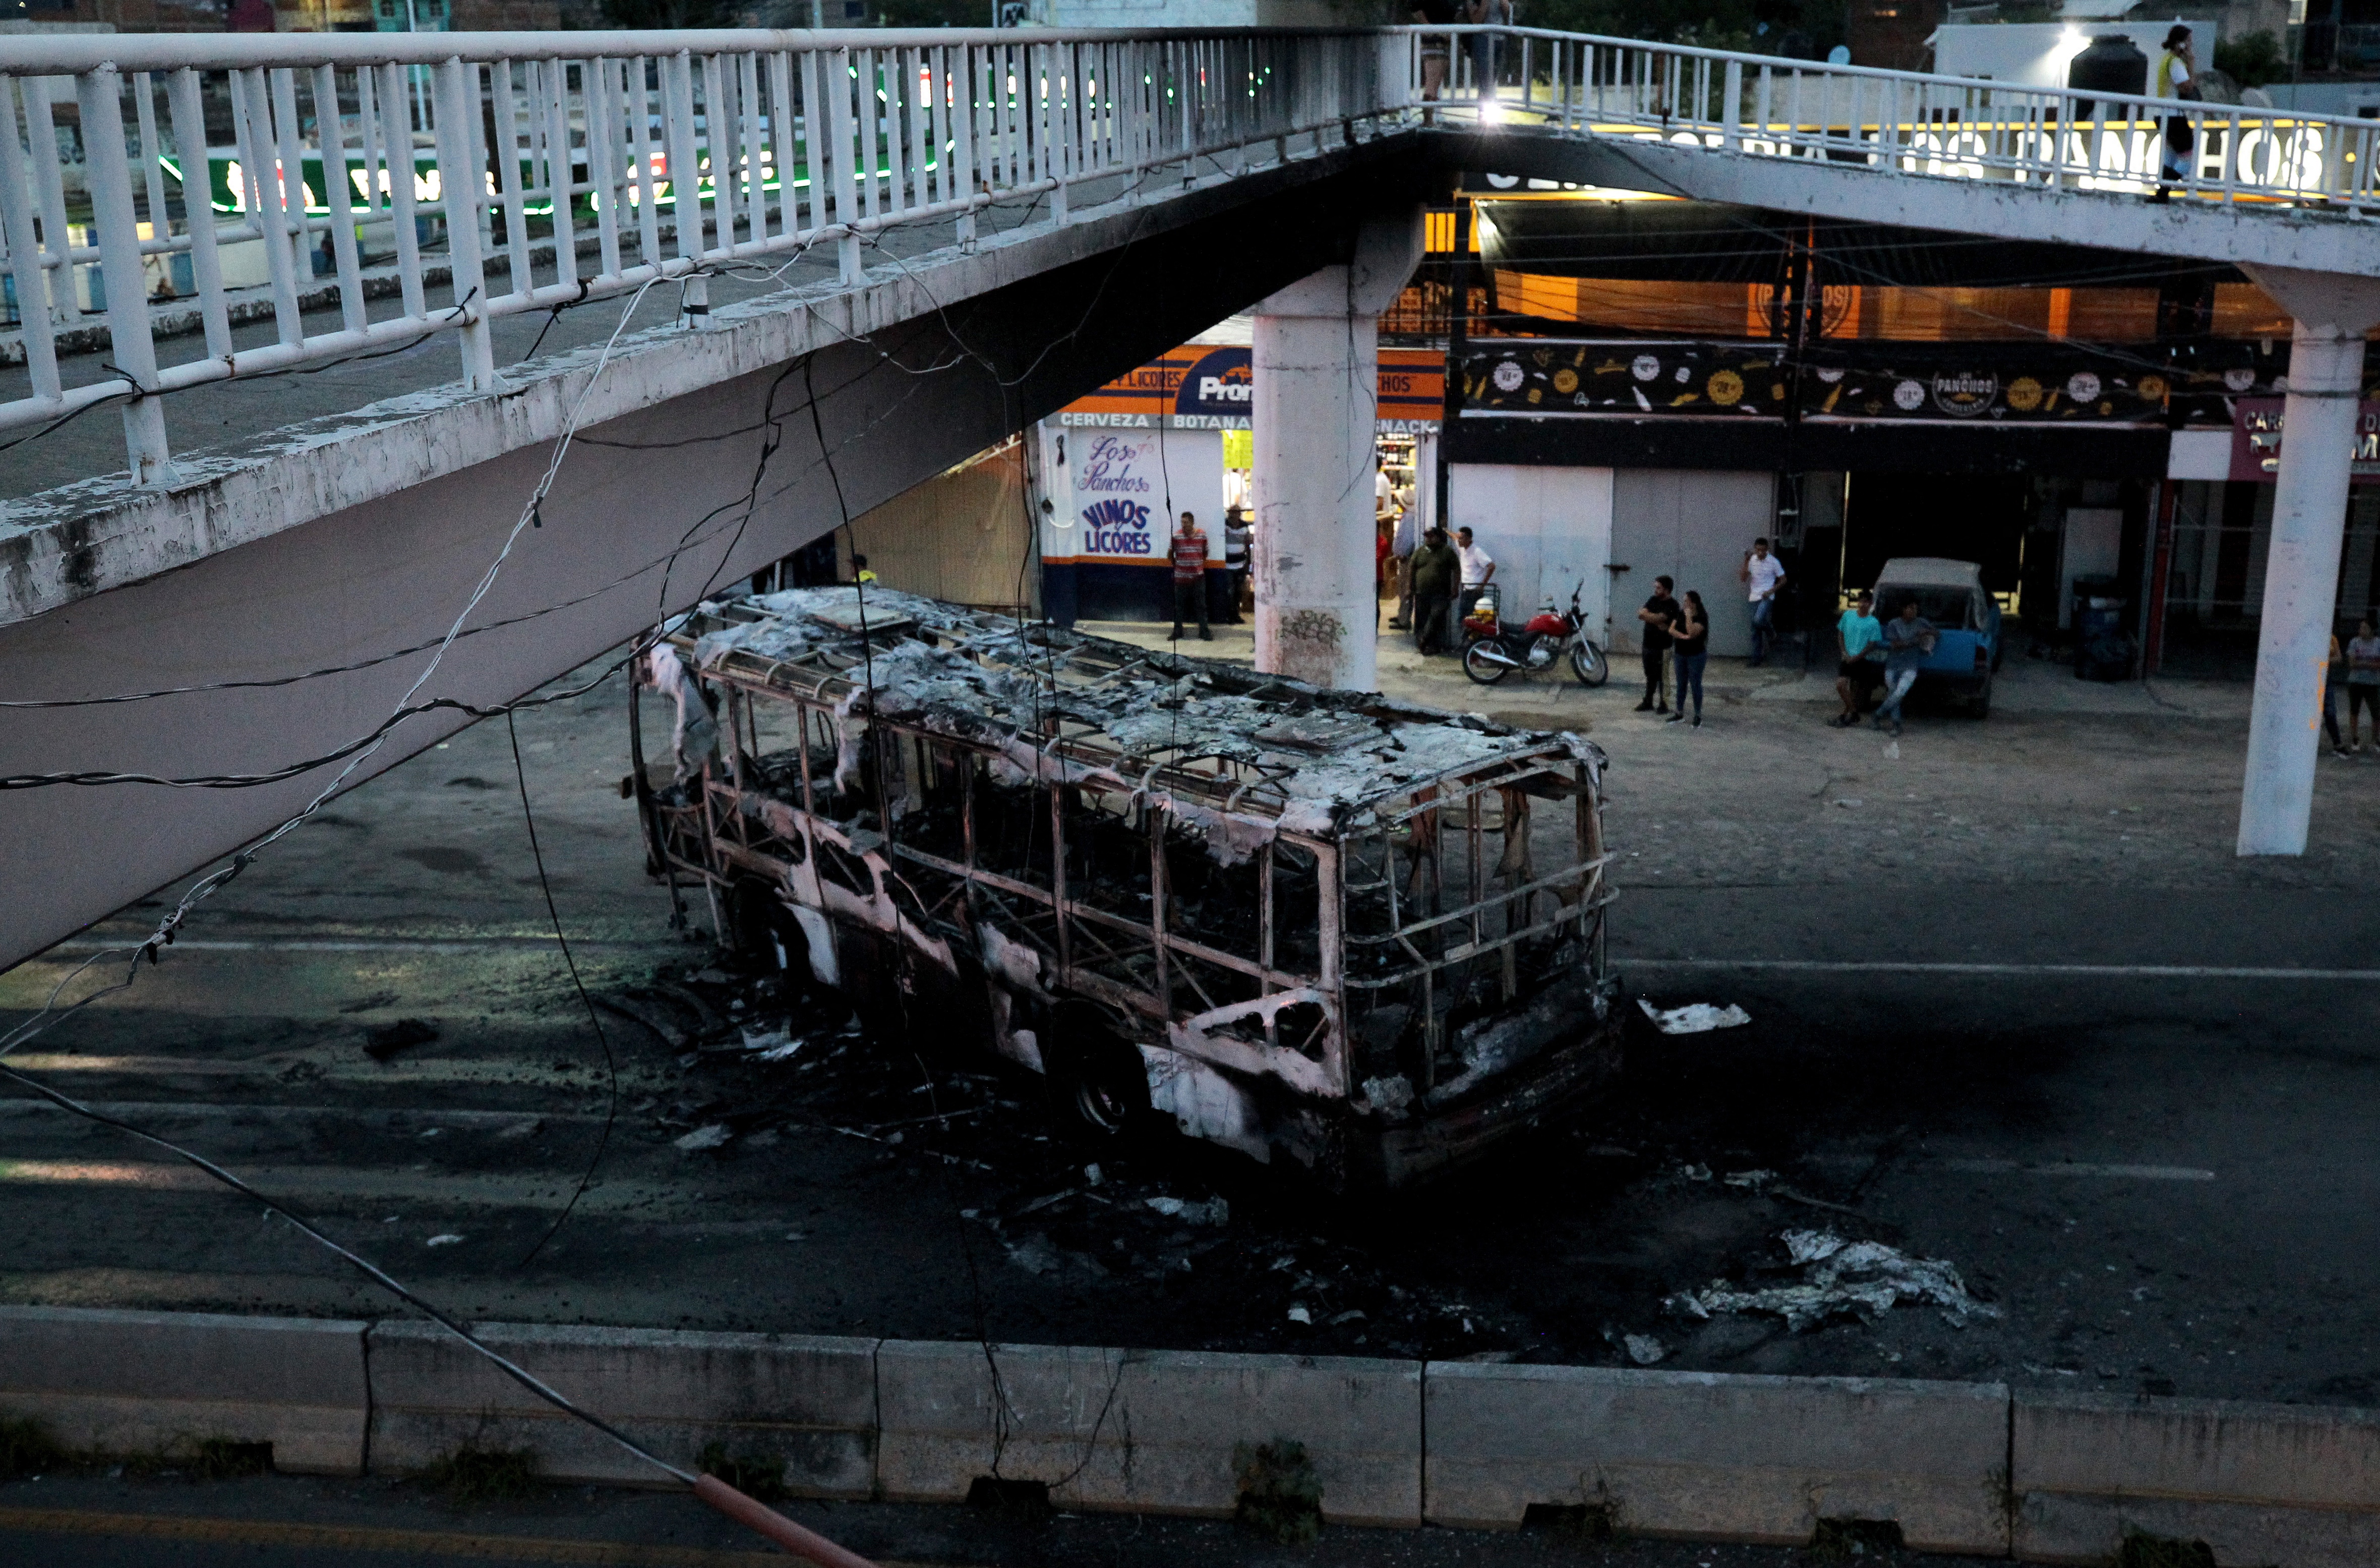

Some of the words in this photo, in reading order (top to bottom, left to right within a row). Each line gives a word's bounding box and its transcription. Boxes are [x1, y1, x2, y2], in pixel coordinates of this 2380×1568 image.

[1128, 371, 1181, 387] LICORES
[1378, 375, 1410, 392] HOS
[1060, 413, 1149, 427] CERVEZA
[1090, 436, 1137, 461] Los
[1078, 460, 1150, 492] Panchos
[1082, 498, 1151, 530] VINOS
[1085, 531, 1151, 554] LICORES
